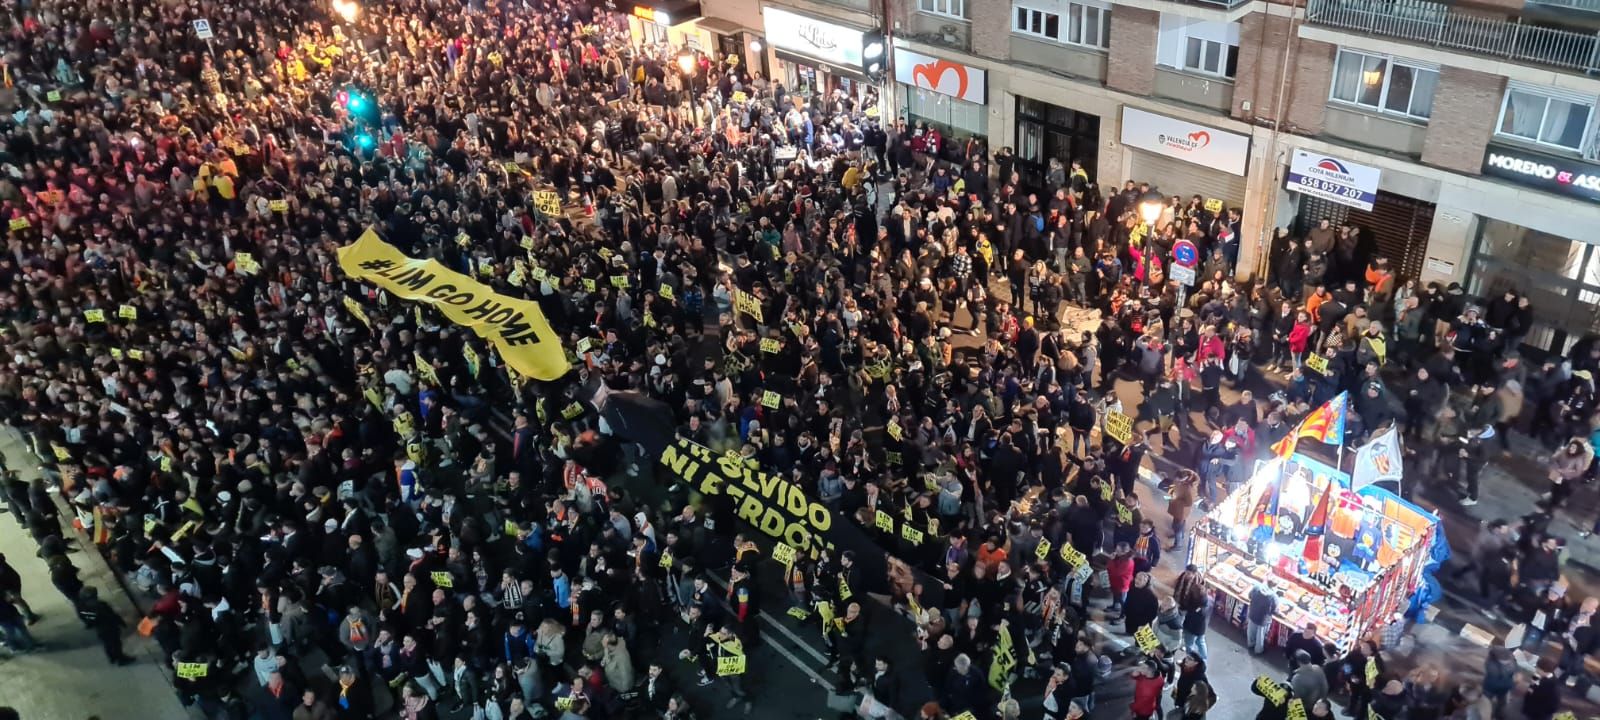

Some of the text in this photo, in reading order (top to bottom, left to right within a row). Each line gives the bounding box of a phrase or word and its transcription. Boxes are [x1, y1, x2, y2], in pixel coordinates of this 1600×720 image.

[1167, 135, 1190, 147] VALENCIA
[1308, 166, 1324, 175] COTA
[1325, 170, 1355, 182] MILENIUM
[1488, 153, 1557, 178] MORENO
[1557, 171, 1573, 183] &
[1301, 176, 1319, 188] 658
[1321, 181, 1340, 194] 057
[1343, 188, 1363, 200] 207
[539, 192, 555, 200] LIM
[358, 258, 437, 291] #LIM
[425, 283, 475, 305] GO
[462, 299, 541, 346] HOME
[740, 289, 755, 303] LIM
[739, 302, 761, 320] HOME
[659, 444, 700, 482] NI
[716, 456, 831, 531] OLVIDO
[879, 513, 890, 521] LIM
[905, 527, 919, 536] LIM
[779, 544, 791, 553] LIM
[1067, 546, 1081, 558] LIM
[774, 553, 791, 564] HOME
[723, 657, 738, 665] LIM
[1263, 677, 1281, 690] LIM
[1295, 703, 1305, 717] LIM
